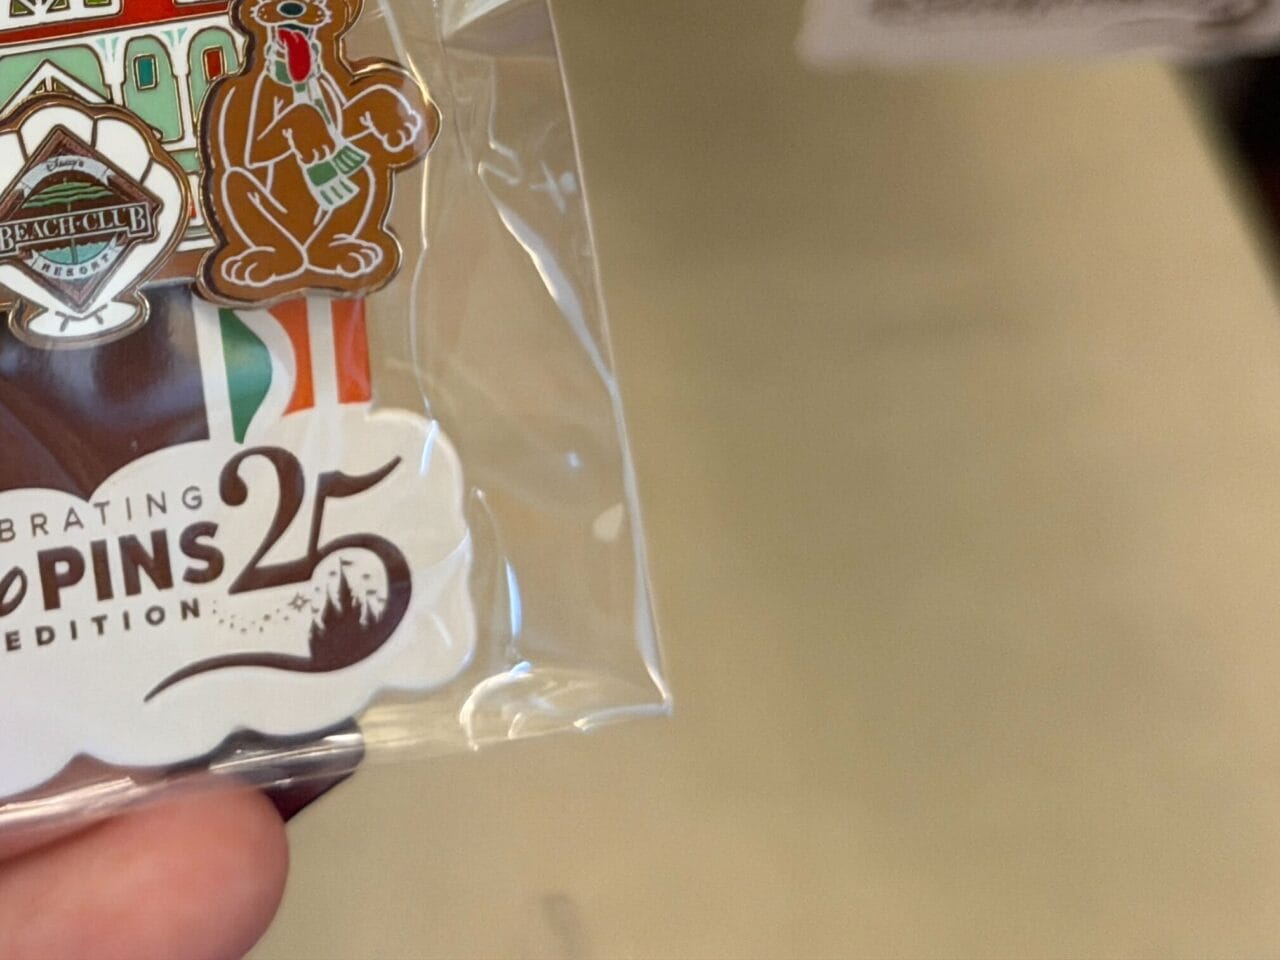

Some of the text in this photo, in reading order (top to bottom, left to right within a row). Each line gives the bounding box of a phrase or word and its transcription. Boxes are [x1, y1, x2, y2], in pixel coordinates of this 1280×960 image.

[42, 253, 110, 277] RESORT
[37, 521, 224, 610] PINS
[145, 446, 412, 702] 25
[5, 597, 201, 651] EDITION
